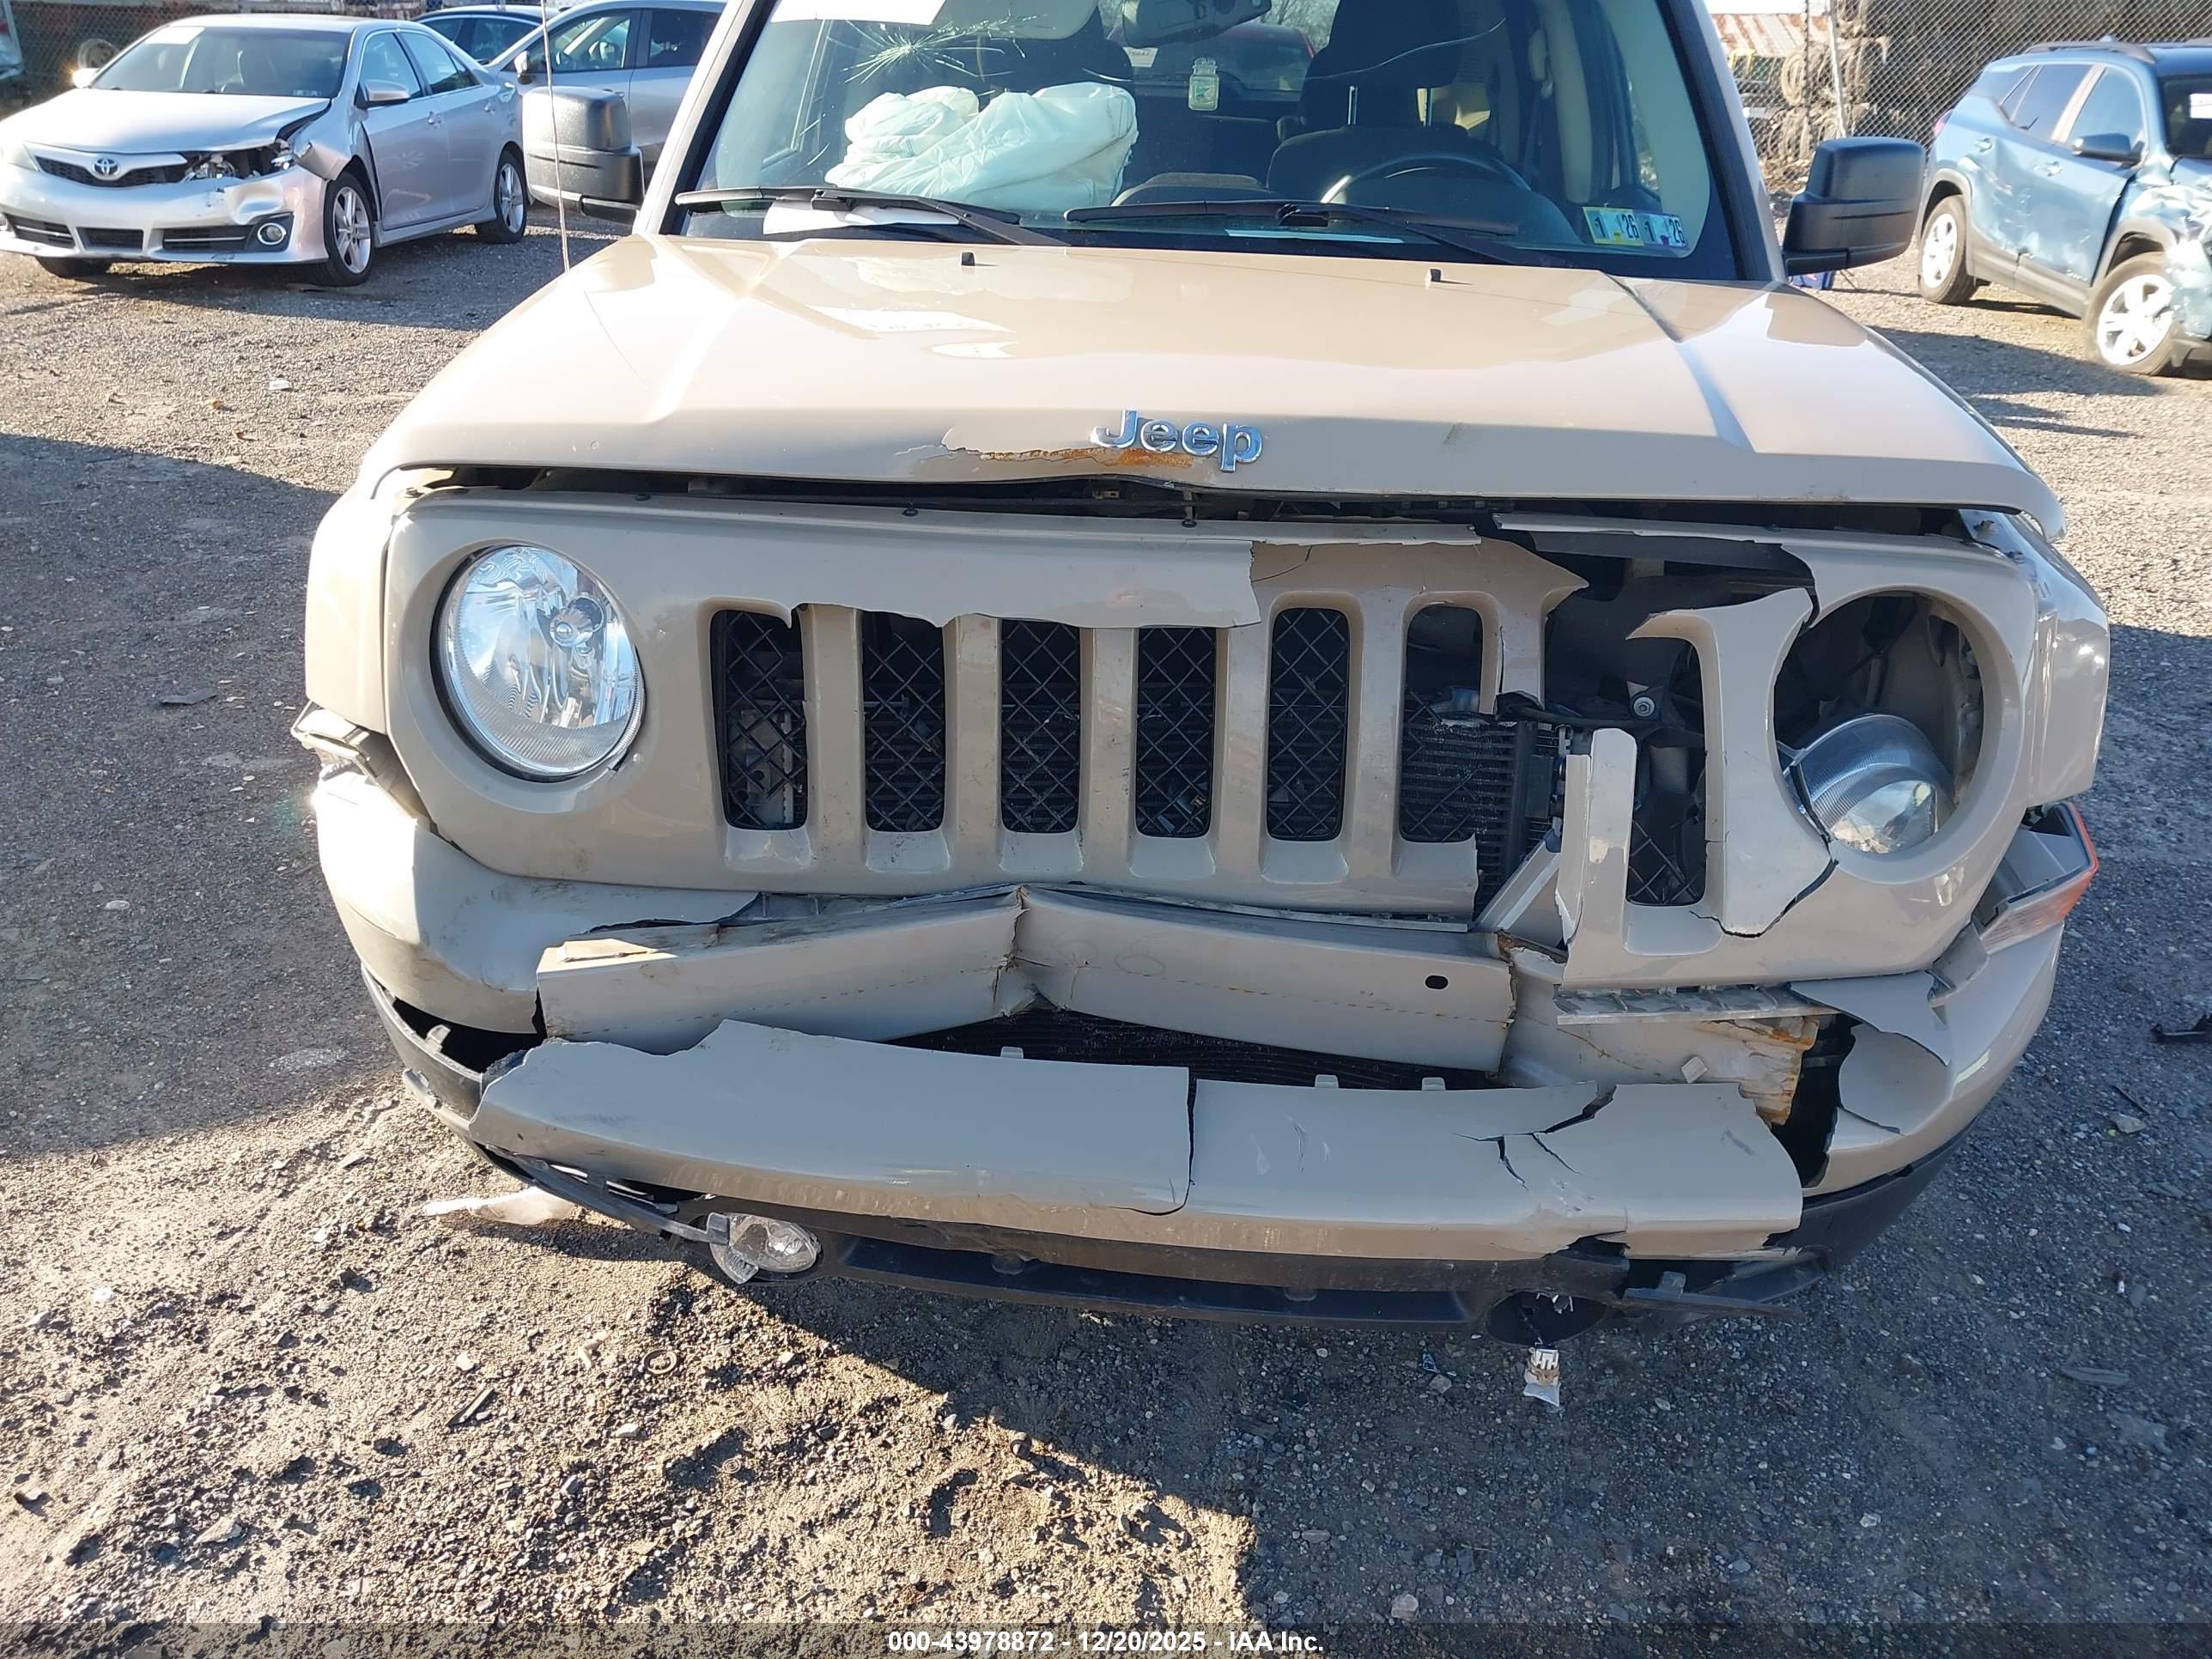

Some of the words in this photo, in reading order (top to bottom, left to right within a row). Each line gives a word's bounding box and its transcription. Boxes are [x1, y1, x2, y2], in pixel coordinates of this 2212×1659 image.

[1595, 216, 1607, 238] 1
[1621, 214, 1640, 239] 26
[1644, 221, 1656, 242] 1
[1668, 218, 1686, 244] 26
[1089, 407, 1263, 472] Jeep
